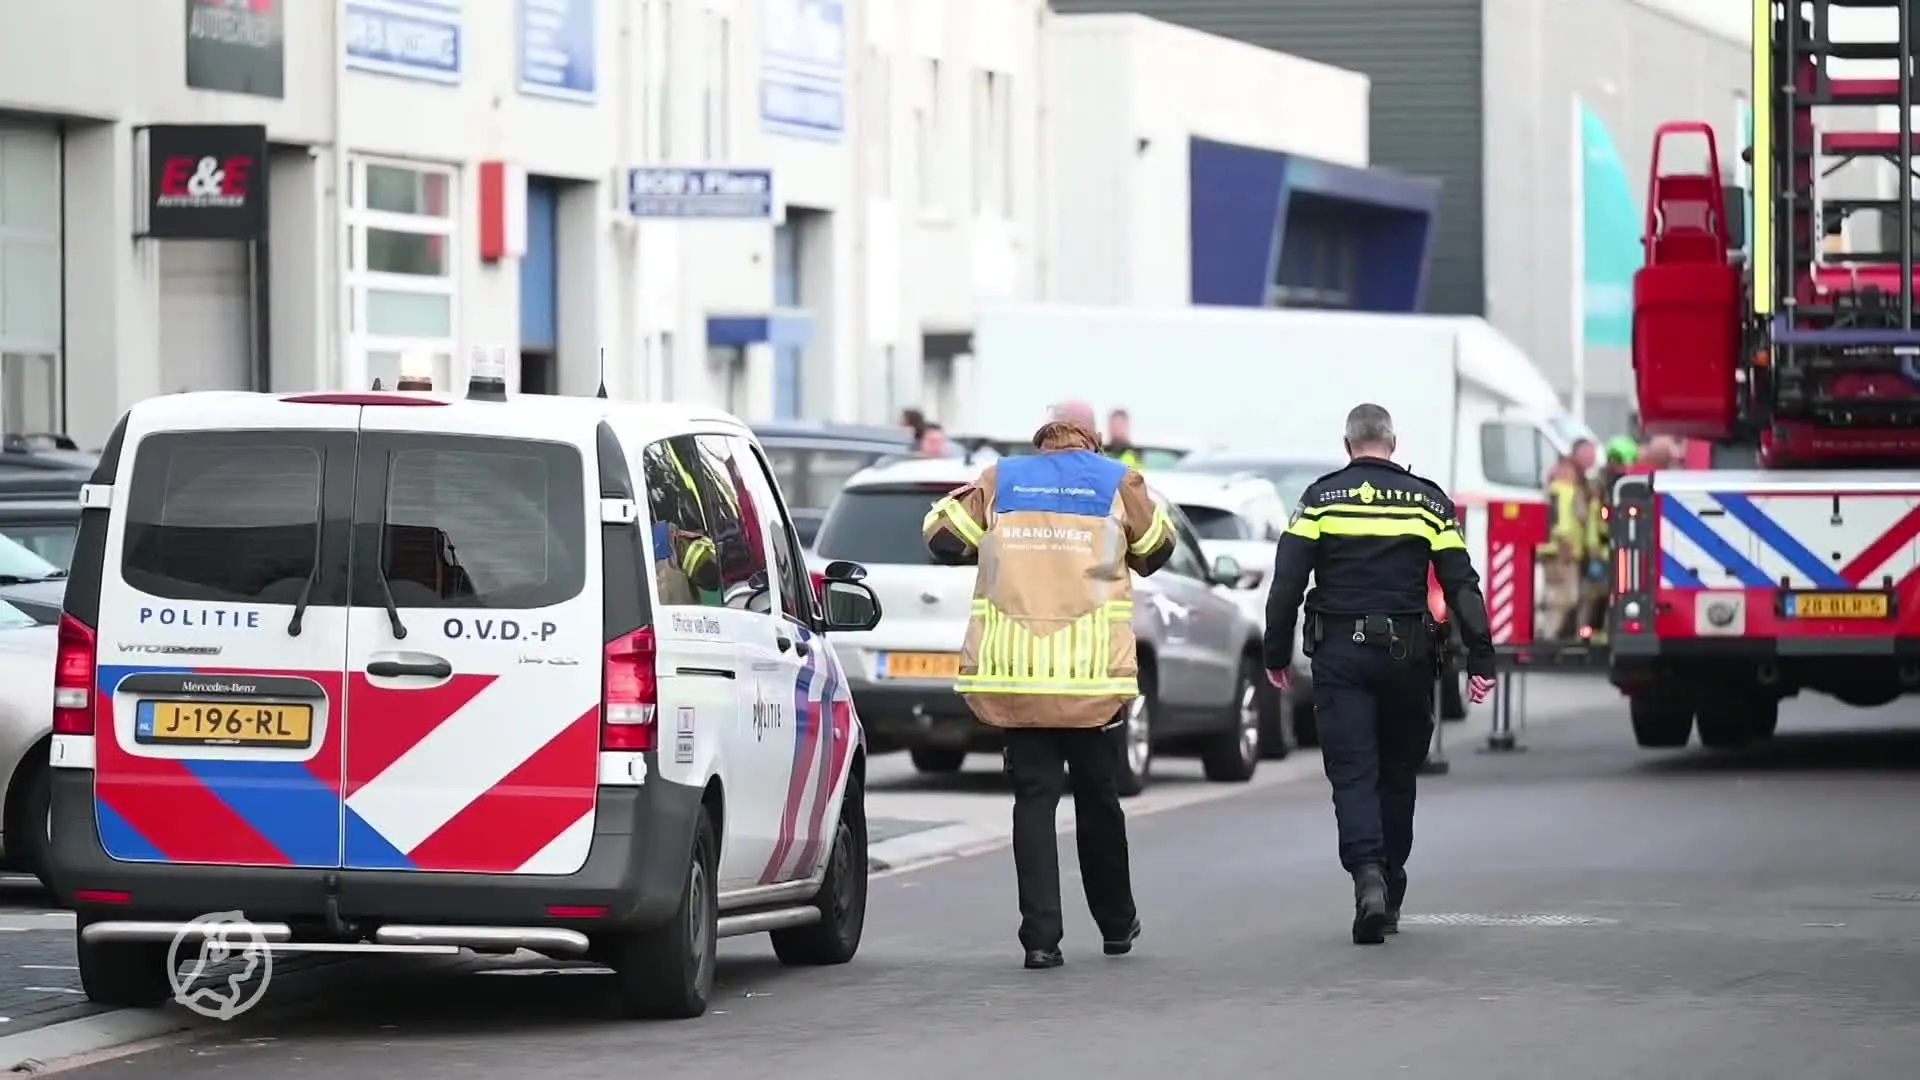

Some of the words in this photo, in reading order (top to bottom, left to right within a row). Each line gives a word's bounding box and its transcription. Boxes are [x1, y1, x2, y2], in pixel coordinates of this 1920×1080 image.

[160, 155, 253, 197] E&E
[1001, 526, 1093, 543] BRANDWEER
[140, 606, 261, 629] POLITIE
[443, 617, 558, 642] O.V.D.-P
[181, 680, 257, 695] Mercedes-Benz
[166, 706, 292, 737] J-196-RL
